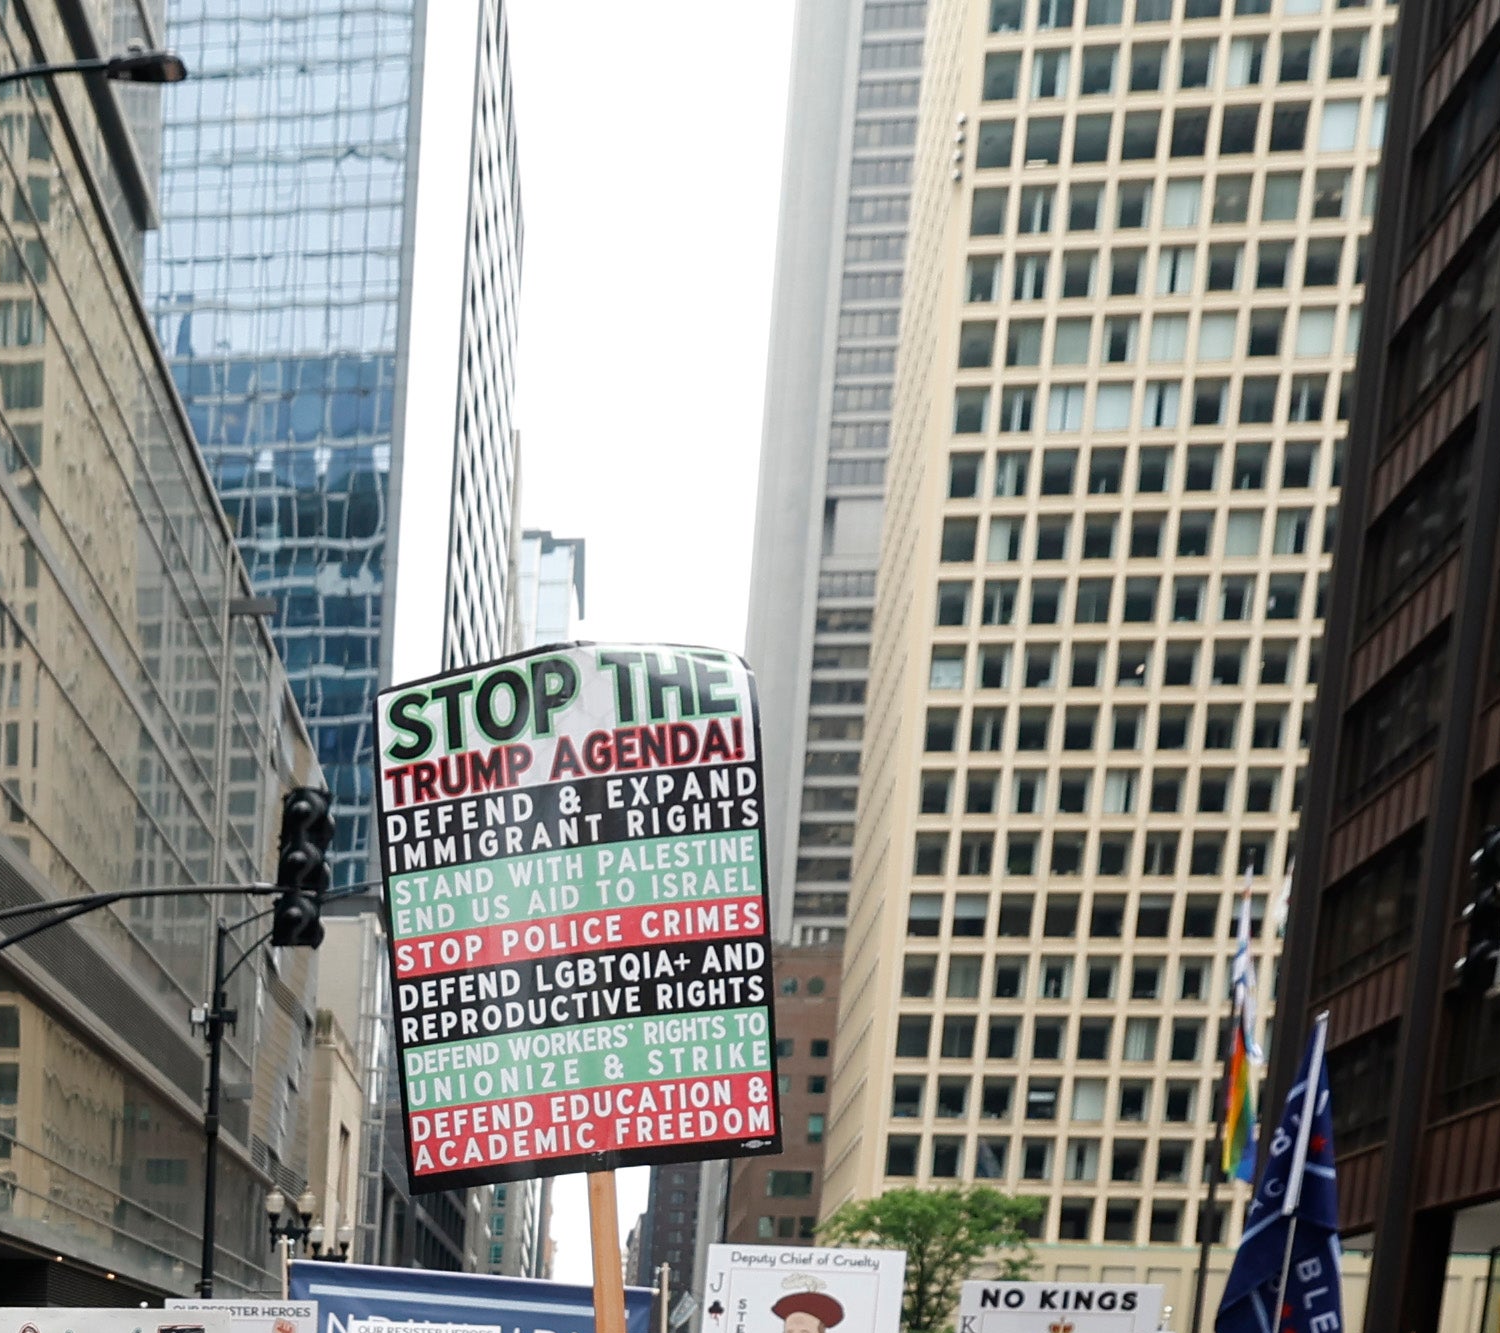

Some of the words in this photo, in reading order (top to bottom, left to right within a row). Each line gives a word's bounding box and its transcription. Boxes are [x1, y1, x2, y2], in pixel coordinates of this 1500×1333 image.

[384, 654, 582, 764] STOP
[596, 646, 744, 726] THE
[384, 742, 534, 808] TRUMP
[549, 716, 746, 780] AGENDA!
[386, 792, 534, 844] DEFEND
[558, 785, 582, 814] &
[606, 766, 758, 810] EXPAND
[388, 813, 602, 873] IMMIGRANT
[628, 799, 760, 838] RIGHTS
[394, 867, 494, 906] STAND
[507, 853, 584, 889] WITH
[597, 835, 756, 879] PALESTINE
[395, 903, 457, 935] END
[472, 895, 512, 922] US
[527, 884, 581, 915] AID
[596, 877, 636, 903] TO
[650, 866, 758, 899] ISRAEL
[396, 934, 483, 972] STOP
[501, 913, 624, 957] POLICE
[640, 901, 762, 939] CRIMES
[399, 968, 521, 1013] DEFEND
[535, 952, 691, 993] LGBTQIA+
[701, 941, 766, 975] AND
[401, 986, 642, 1044] REPRODUCTIVE
[656, 974, 766, 1010] RIGHTS
[407, 1040, 499, 1077] DEFEND
[507, 1022, 635, 1063] WORKERS'
[643, 1014, 727, 1046] RIGHTS
[733, 1011, 766, 1037] TO
[408, 1058, 580, 1107] UNIONIZE
[603, 1052, 624, 1081] &
[647, 1040, 768, 1076] STRIKE
[411, 1101, 535, 1143] DEFEND
[550, 1079, 732, 1124] EDUCATION
[747, 1075, 769, 1101] &
[413, 1122, 597, 1172] ACADEMIC
[615, 1104, 771, 1145] FREEDOM
[731, 1251, 776, 1268] Deputy
[780, 1252, 814, 1265] Chief
[817, 1253, 832, 1266] of
[833, 1255, 881, 1270] Cruelty
[261, 1306, 311, 1318] HEROES
[980, 1287, 1026, 1310] NO
[1039, 1288, 1139, 1312] KINGS
